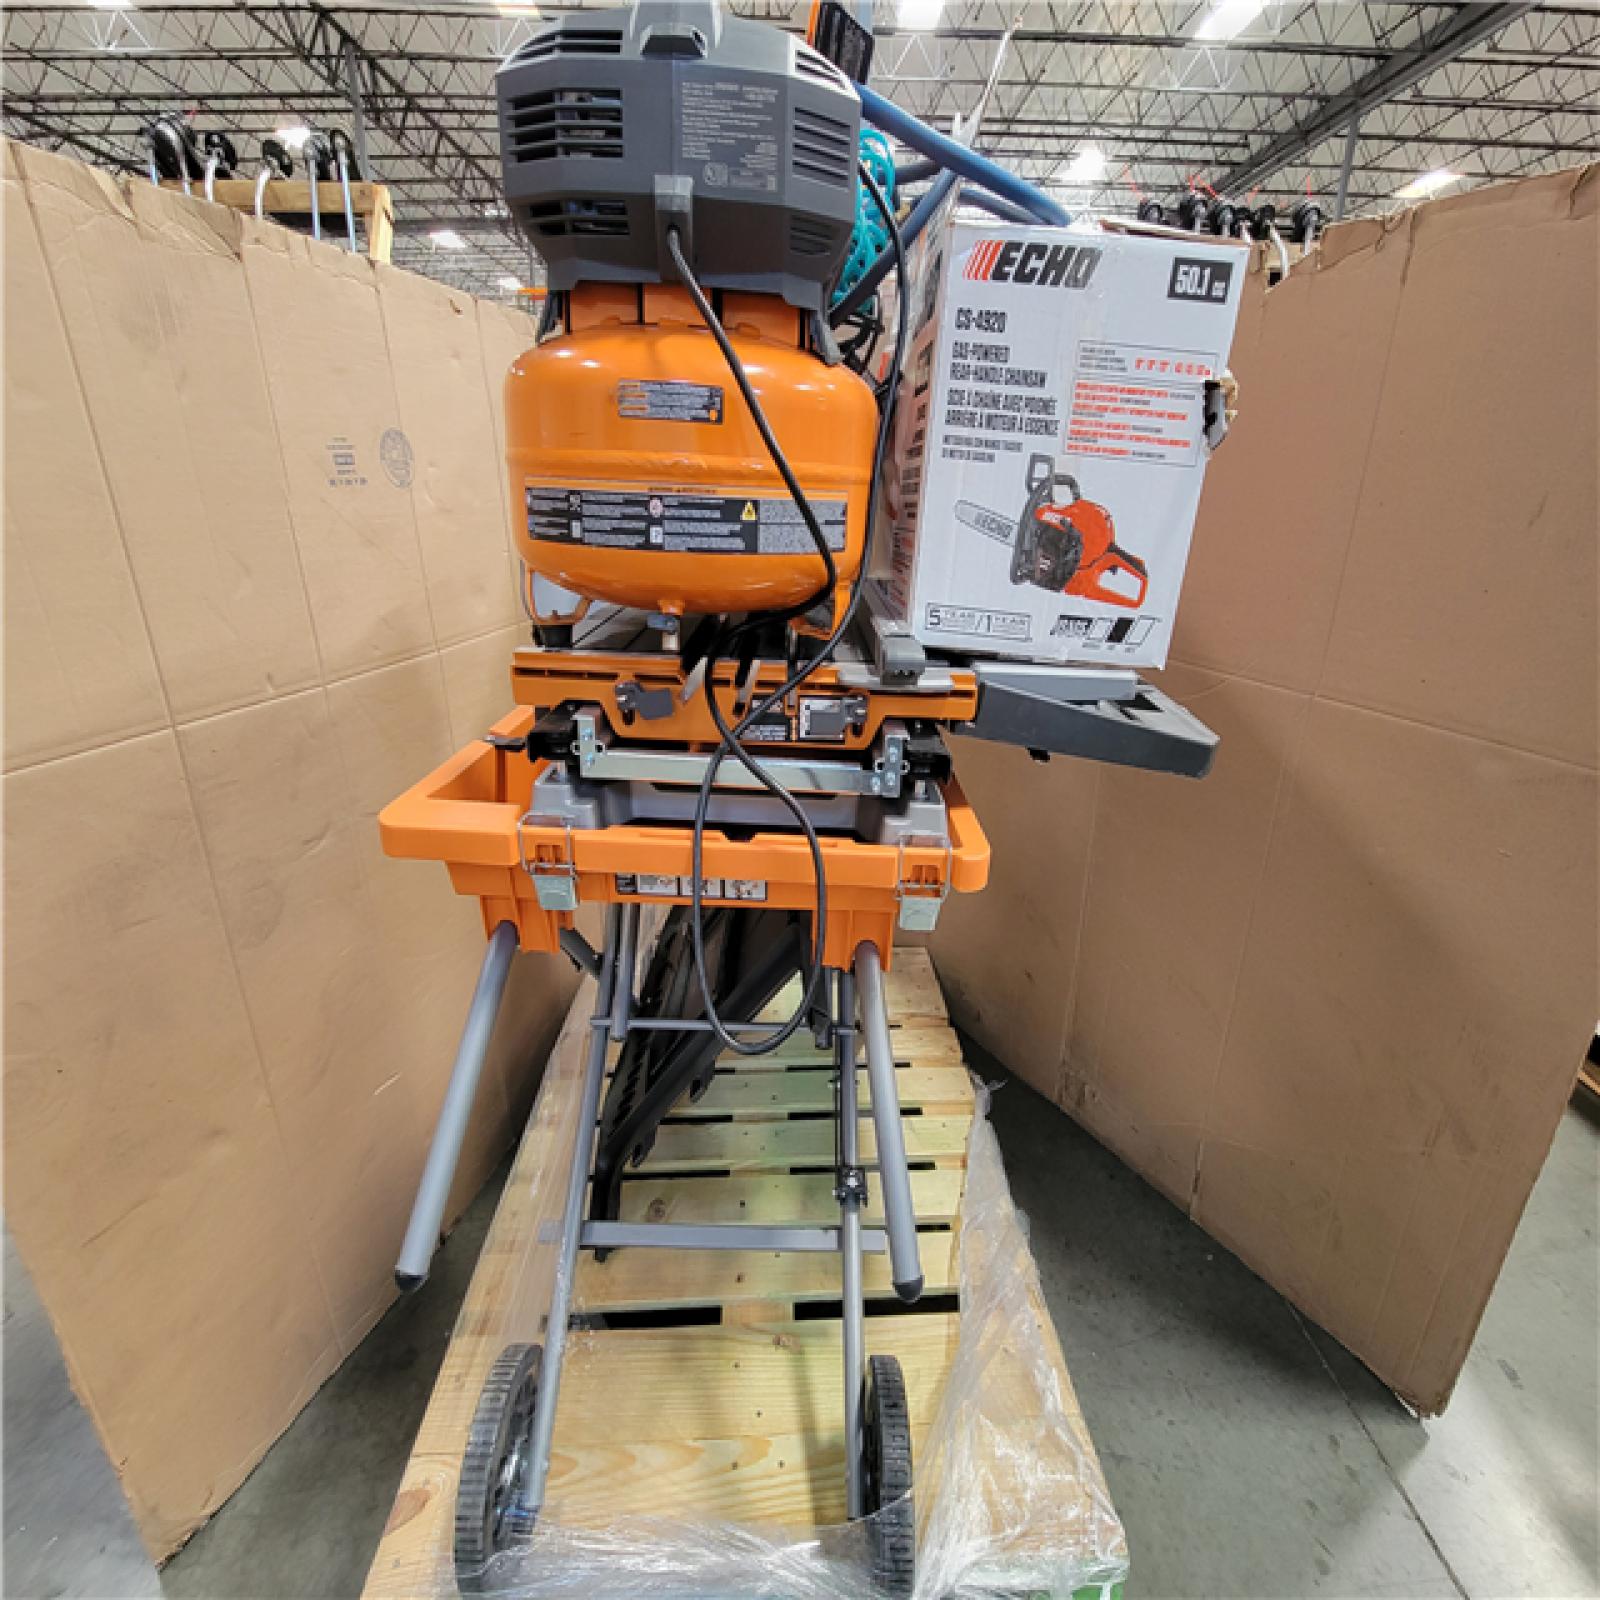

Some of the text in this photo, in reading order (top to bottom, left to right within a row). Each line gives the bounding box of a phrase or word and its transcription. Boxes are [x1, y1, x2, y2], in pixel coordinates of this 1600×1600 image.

[992, 241, 1101, 289] ECHO
[1175, 265, 1211, 296] 50.1
[955, 307, 1006, 333] CS-4920
[952, 341, 1010, 363] GAS-POWERED
[950, 362, 1047, 388] REAR-HANDLE CHAINSAW
[930, 609, 941, 626] 5
